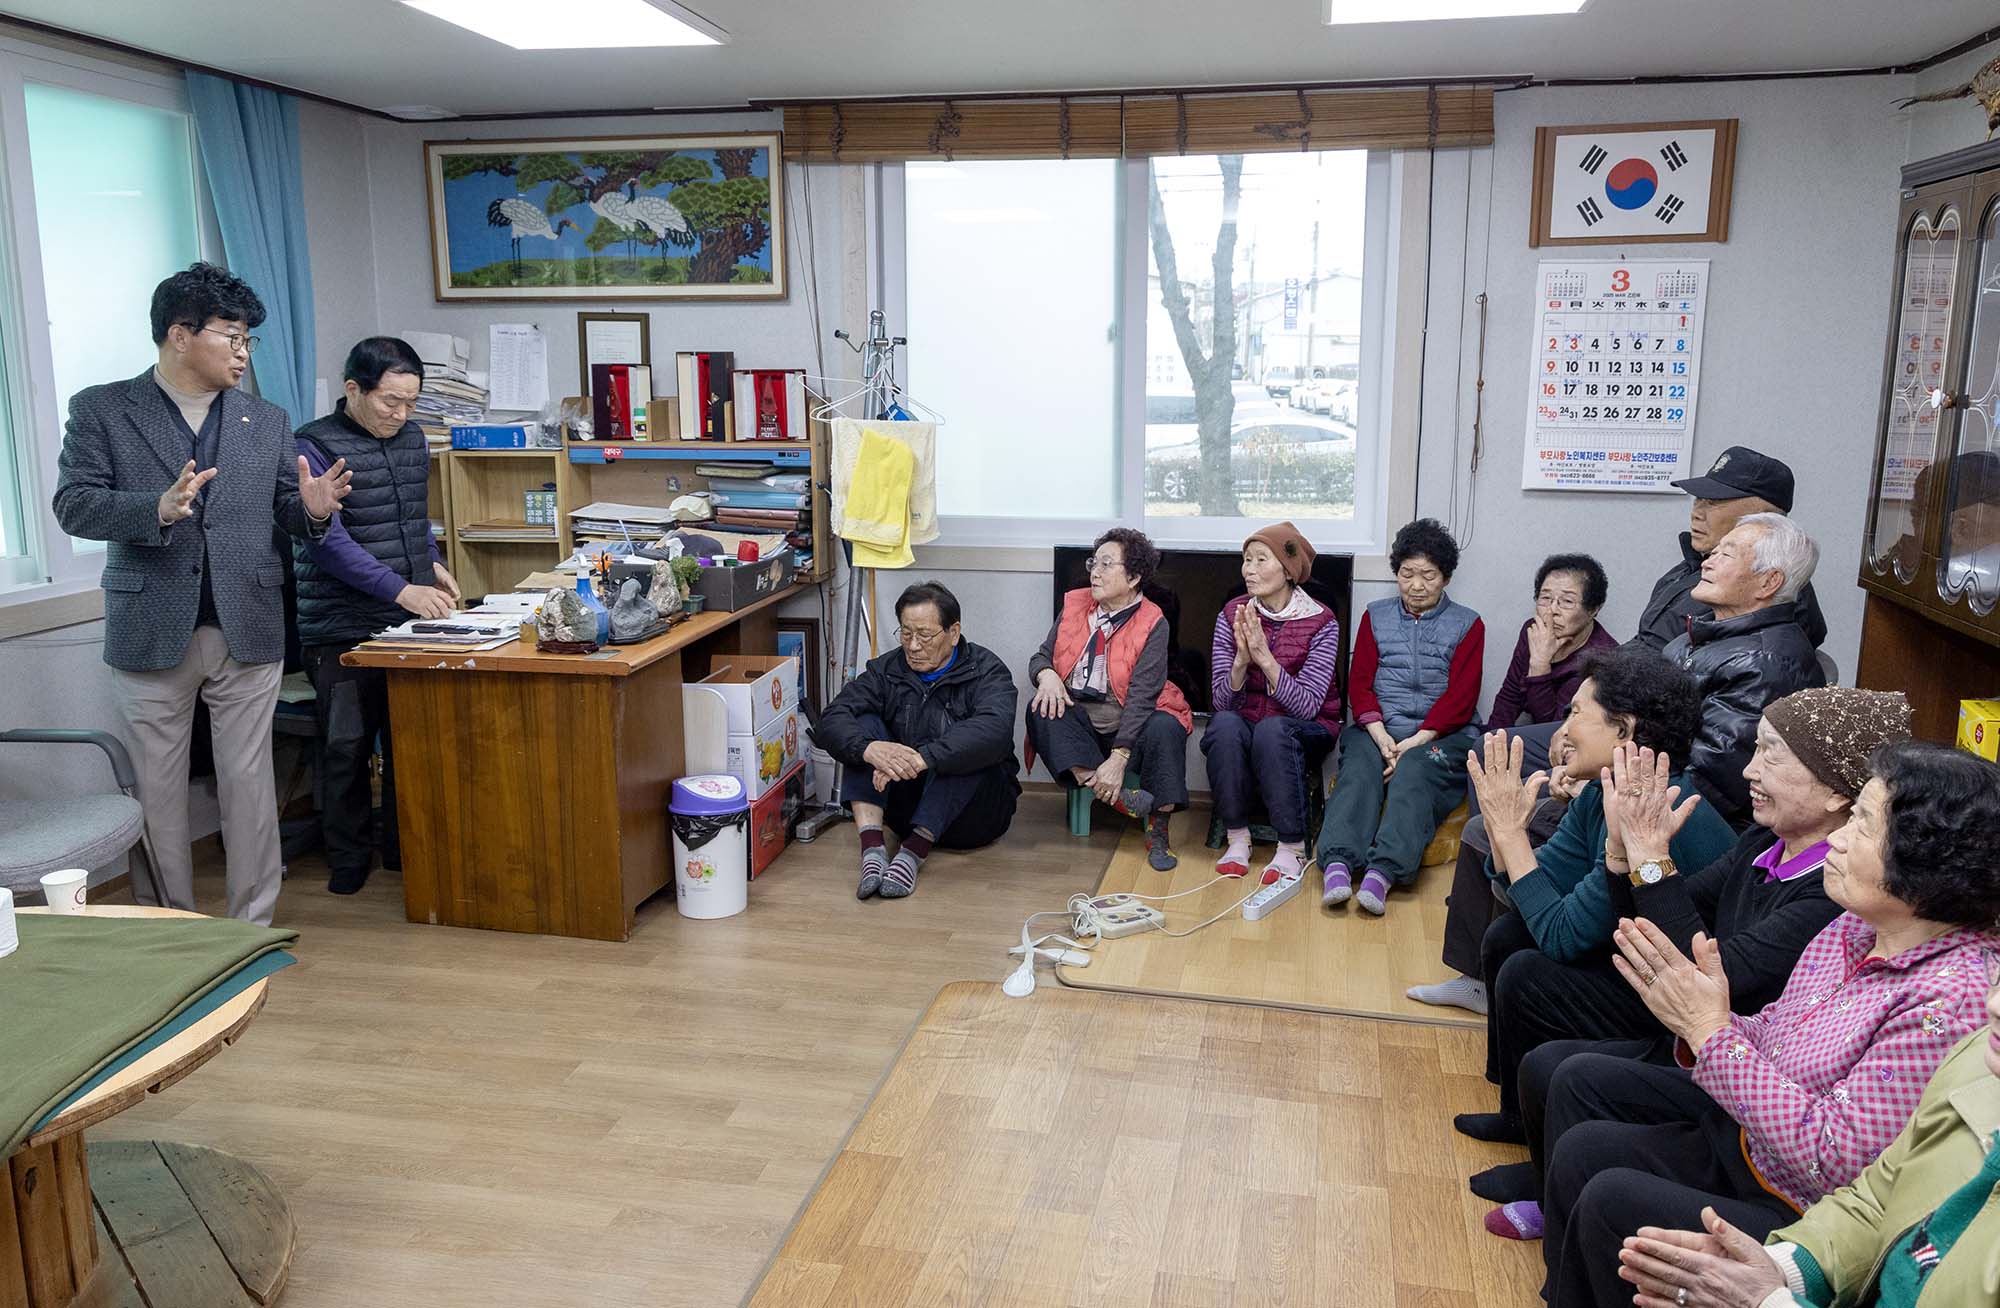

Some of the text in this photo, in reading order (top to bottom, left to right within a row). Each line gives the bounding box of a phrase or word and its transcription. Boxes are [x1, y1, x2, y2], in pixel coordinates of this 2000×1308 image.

[1611, 270, 1631, 292] 3
[1570, 301, 1582, 309] 月
[1680, 316, 1687, 328] 1
[1549, 338, 1684, 351] 2 3 4 5 6 7 8
[1547, 360, 1685, 374] 9 10 11 12 13 14 15
[1543, 383, 1685, 397] 16 17 18 19 20 21 22
[1583, 407, 1598, 418] 25
[1604, 407, 1619, 418] 26
[1625, 407, 1641, 418] 27
[1646, 408, 1662, 419] 28
[1667, 408, 1683, 421] 29
[1540, 450, 1678, 463] 부모사랑노인복지센터 부모사랑노인주간보호센터
